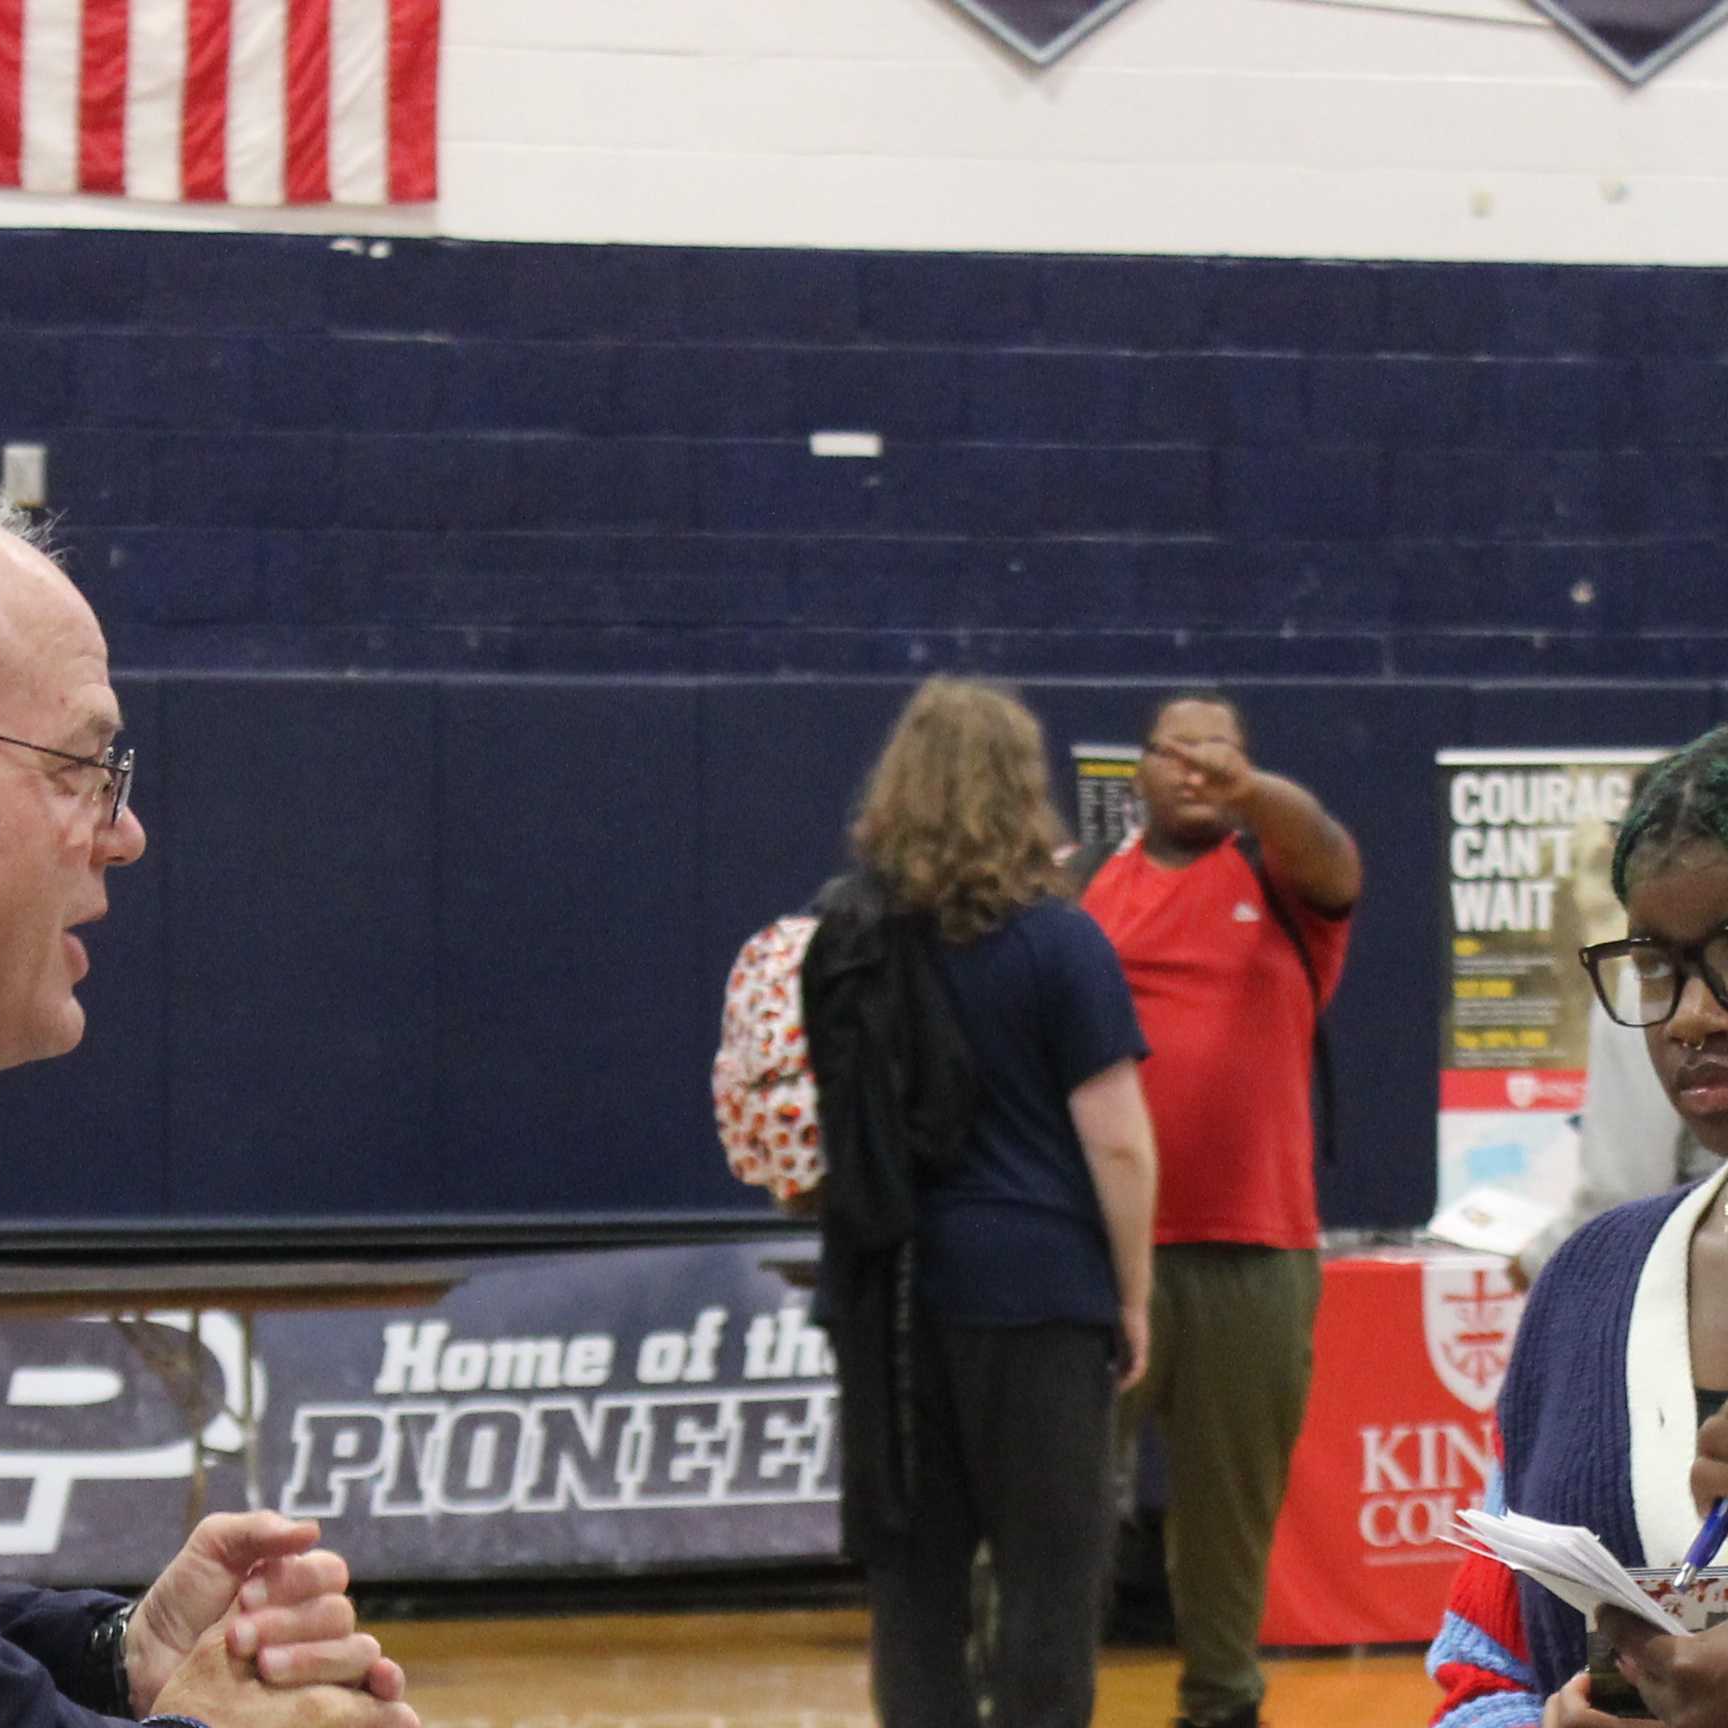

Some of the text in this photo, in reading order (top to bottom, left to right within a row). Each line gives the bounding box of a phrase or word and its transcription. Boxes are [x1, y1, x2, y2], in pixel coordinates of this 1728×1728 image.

[1451, 828, 1575, 878] CAN'T
[1452, 880, 1556, 932] WAIT
[375, 1321, 613, 1395] Home
[637, 1309, 727, 1385] of
[281, 1386, 842, 1516] PIONEE
